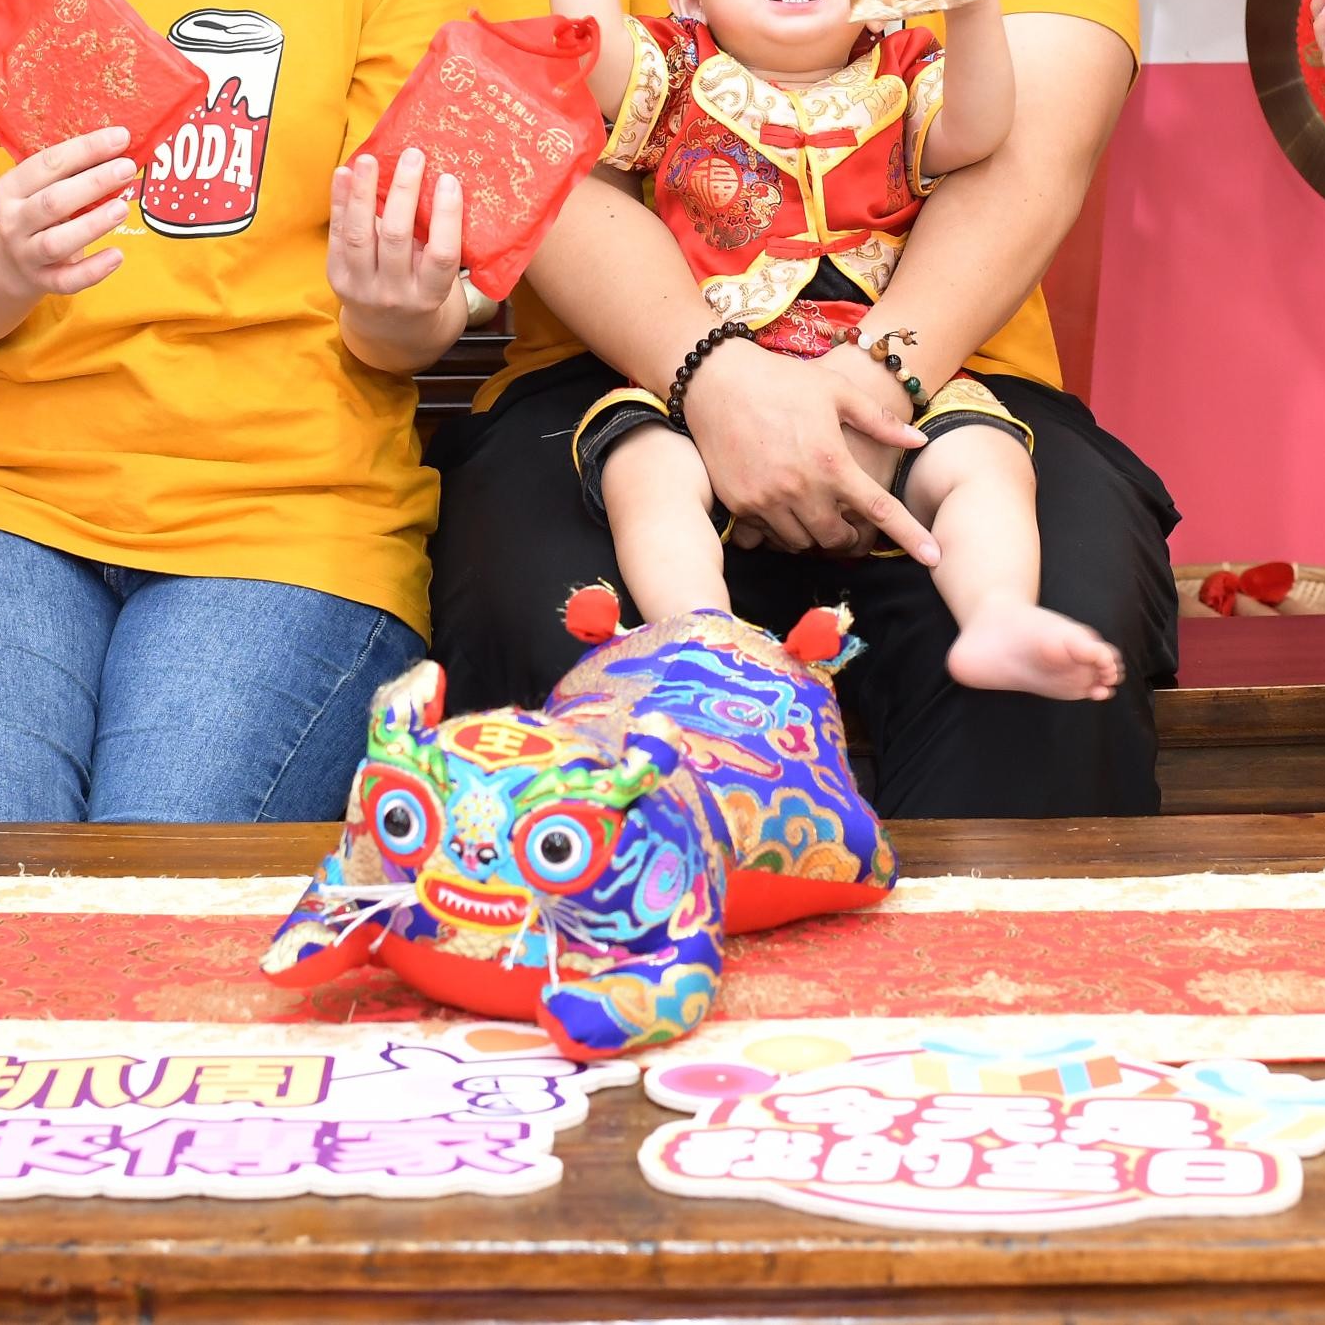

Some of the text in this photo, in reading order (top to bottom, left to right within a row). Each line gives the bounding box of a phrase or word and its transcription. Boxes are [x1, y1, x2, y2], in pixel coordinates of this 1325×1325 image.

[440, 55, 476, 93] 祈
[150, 123, 253, 188] SODA
[536, 127, 574, 166] 福
[691, 157, 739, 209] 福
[473, 725, 529, 757] 王
[767, 1086, 1218, 1151] 今天是
[668, 1127, 1269, 1198] 我的生日
